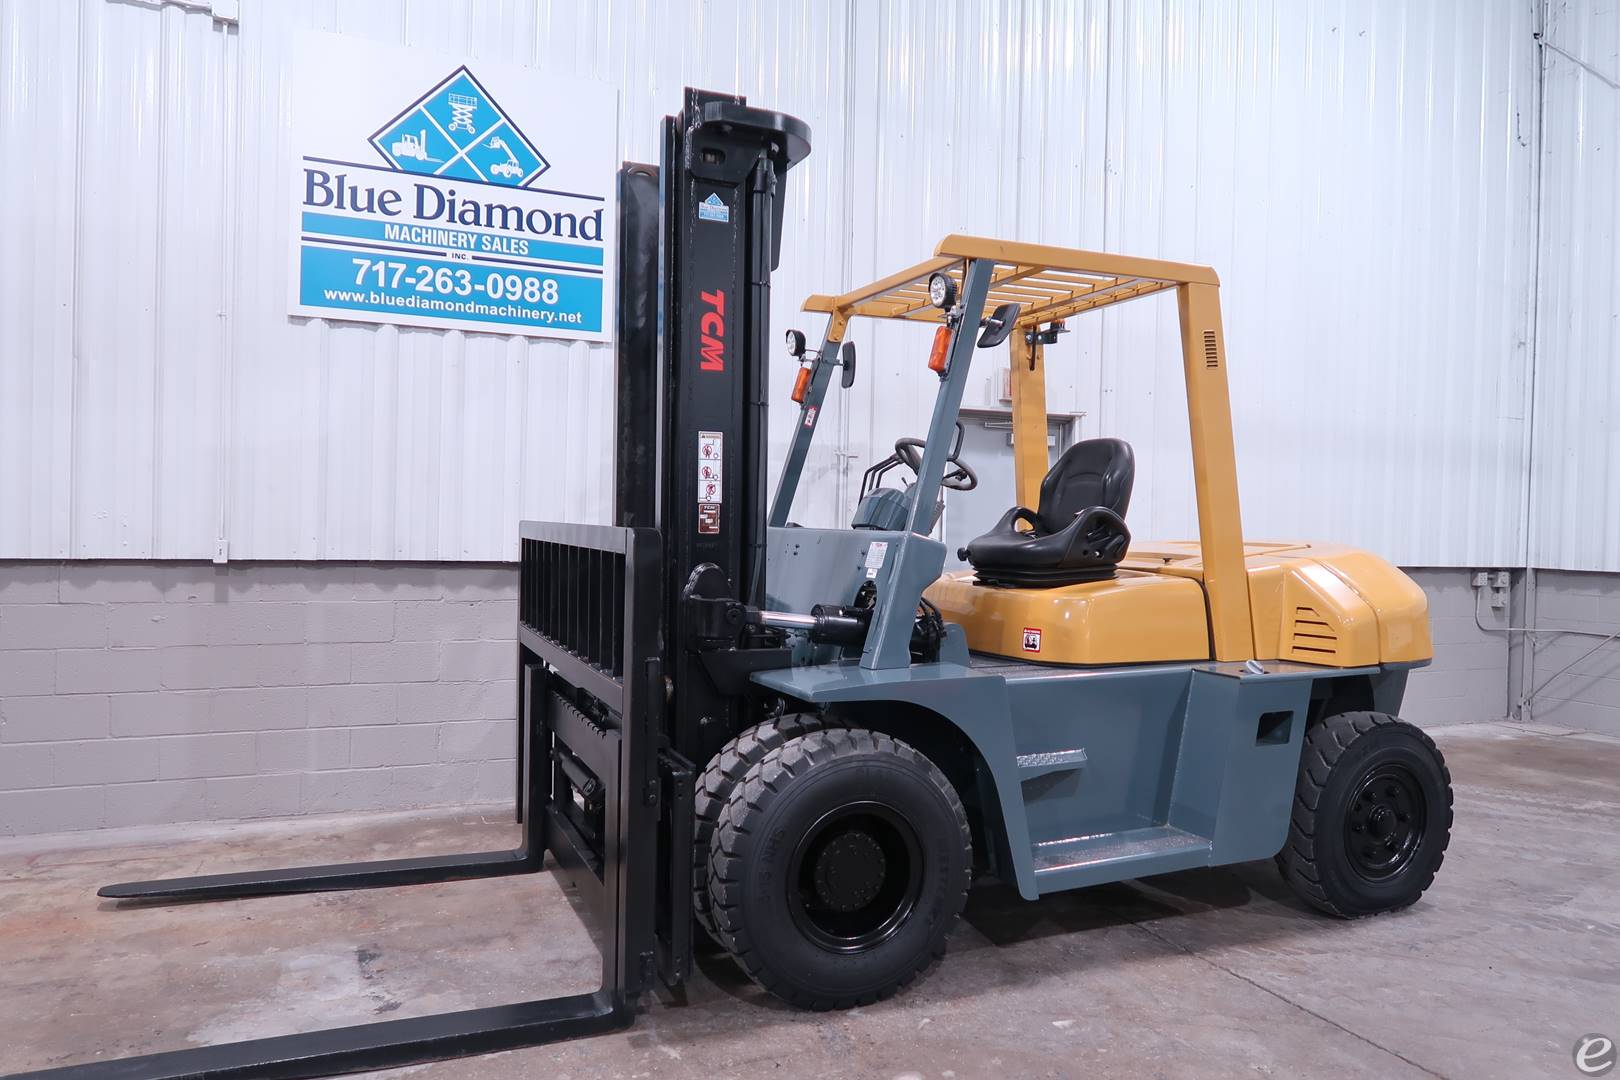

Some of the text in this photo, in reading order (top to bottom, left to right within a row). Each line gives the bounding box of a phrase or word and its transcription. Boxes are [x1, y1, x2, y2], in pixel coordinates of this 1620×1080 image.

[303, 168, 605, 242] Blue Diamond
[384, 223, 529, 255] MACHINERY SALES
[352, 257, 559, 305] 717-263-0988
[324, 288, 582, 324] www.bluediamondmachinery.net
[700, 289, 725, 372] TCM
